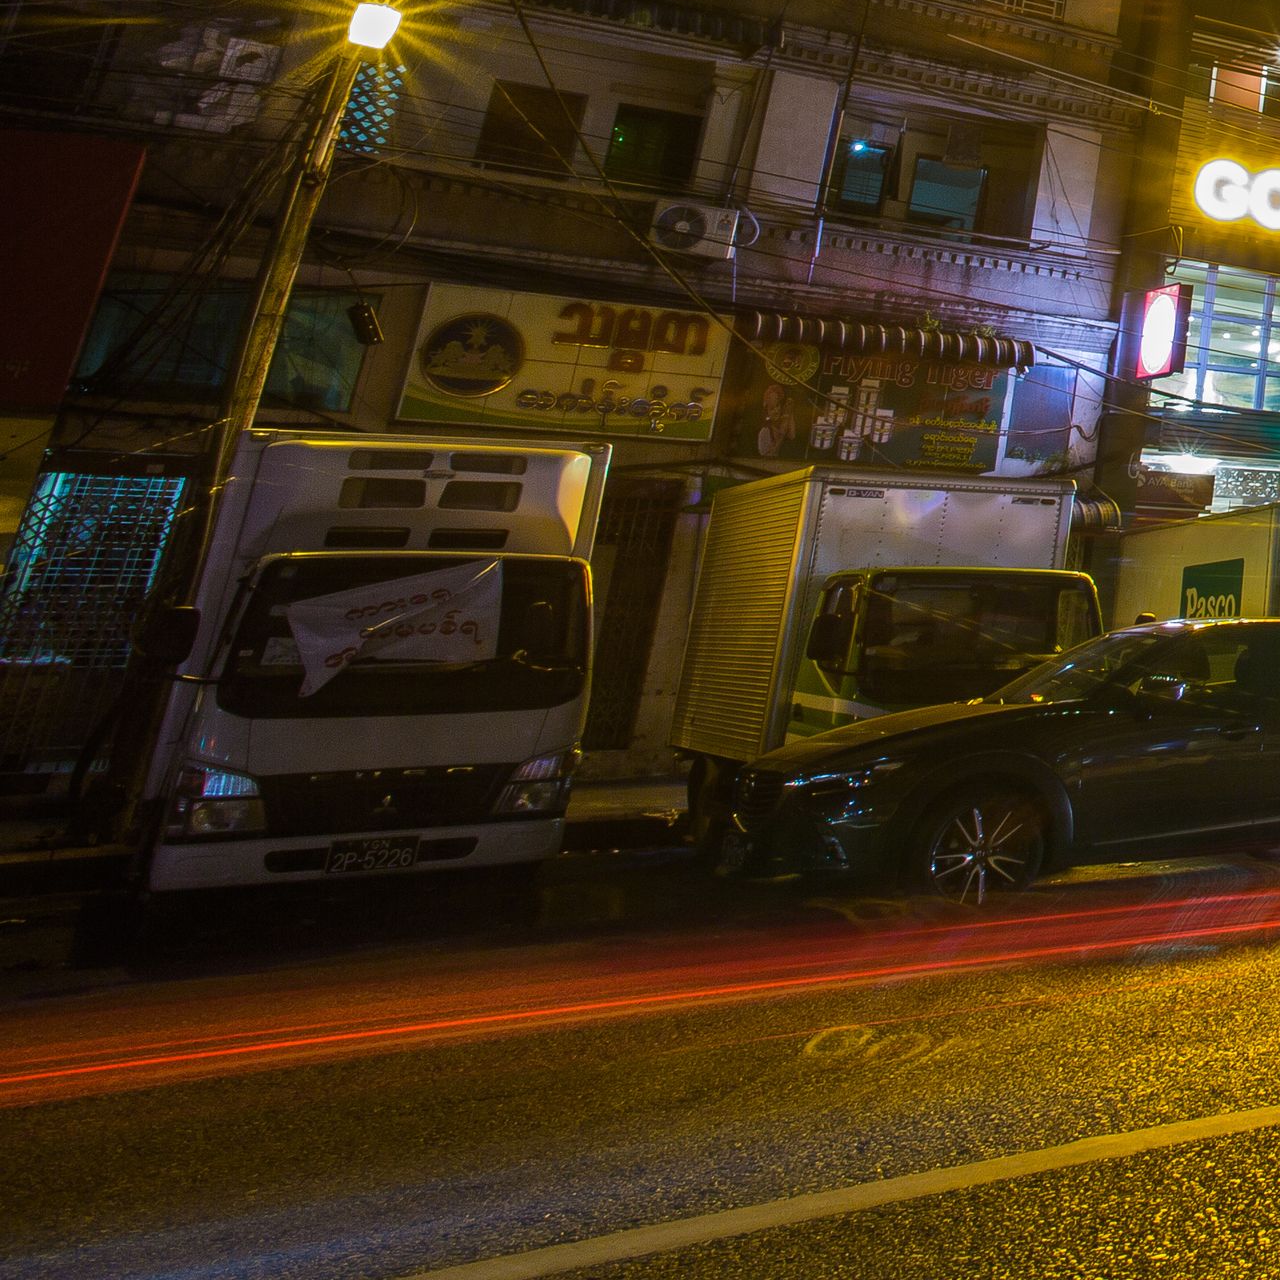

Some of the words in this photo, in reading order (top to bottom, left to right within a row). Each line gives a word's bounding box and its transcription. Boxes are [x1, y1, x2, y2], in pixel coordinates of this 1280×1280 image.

[823, 353, 920, 388] Flying
[923, 360, 1000, 392] Tiger
[1148, 476, 1168, 487] AYA
[1170, 478, 1194, 489] Bank
[847, 489, 884, 498] D-VAN
[1185, 586, 1237, 618] Pasco
[362, 839, 391, 849] YGN
[331, 847, 413, 872] 2P-5226
